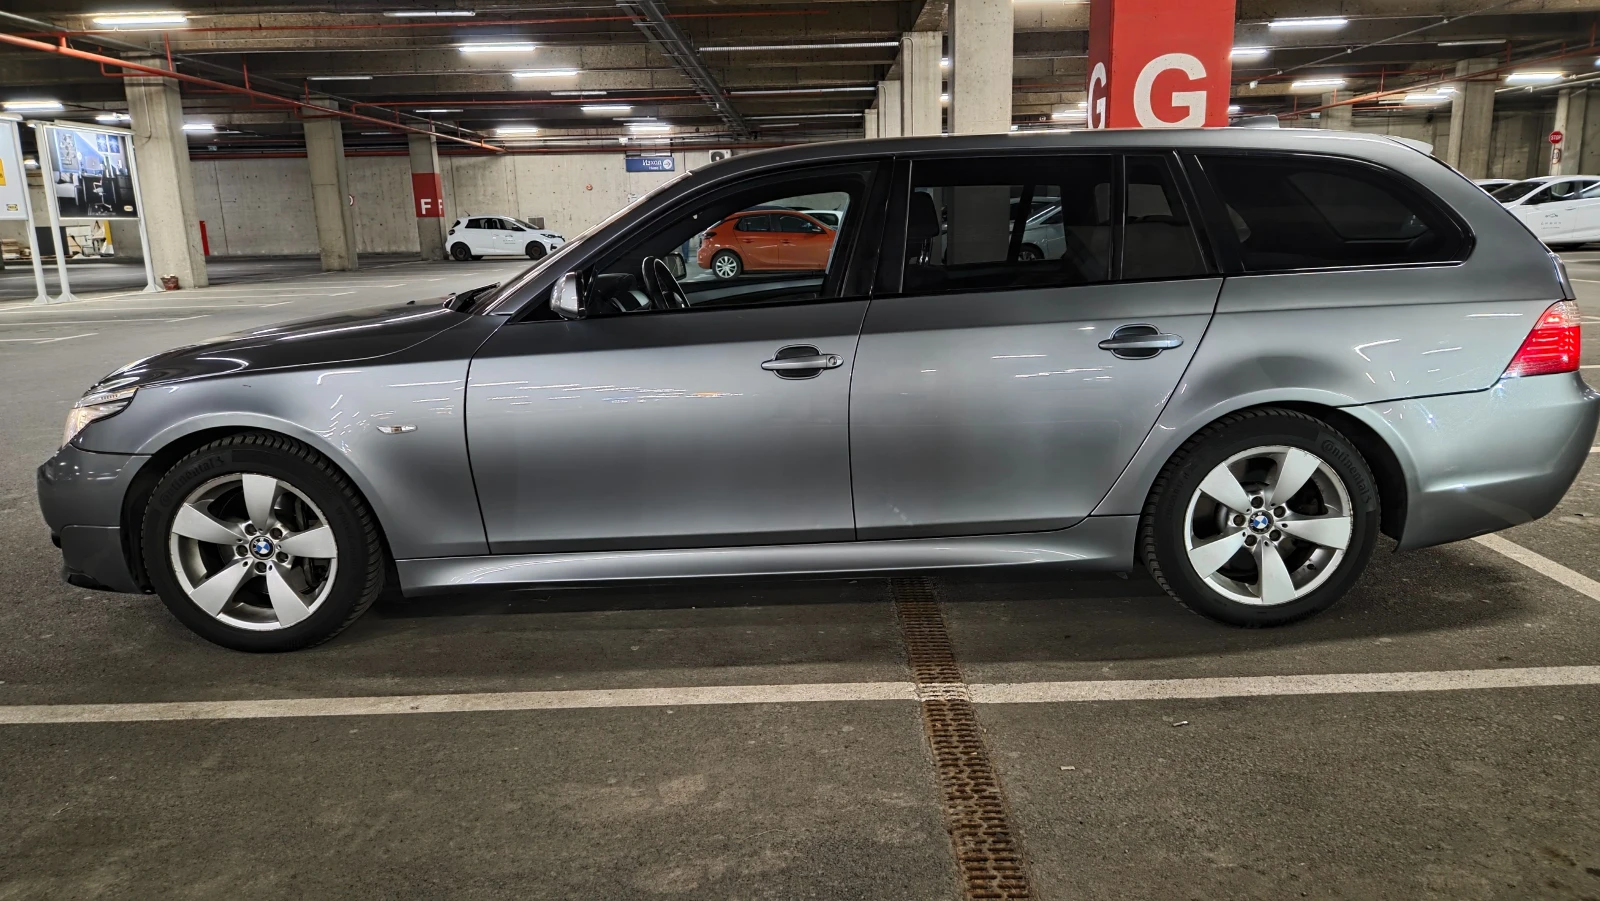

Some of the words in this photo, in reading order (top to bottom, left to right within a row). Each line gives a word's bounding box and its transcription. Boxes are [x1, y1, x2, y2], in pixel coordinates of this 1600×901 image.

[1088, 62, 1107, 129] G
[1133, 52, 1207, 128] G
[420, 199, 432, 215] F
[438, 199, 443, 215] F
[159, 458, 217, 508] Continental
[1321, 439, 1370, 496] Continental
